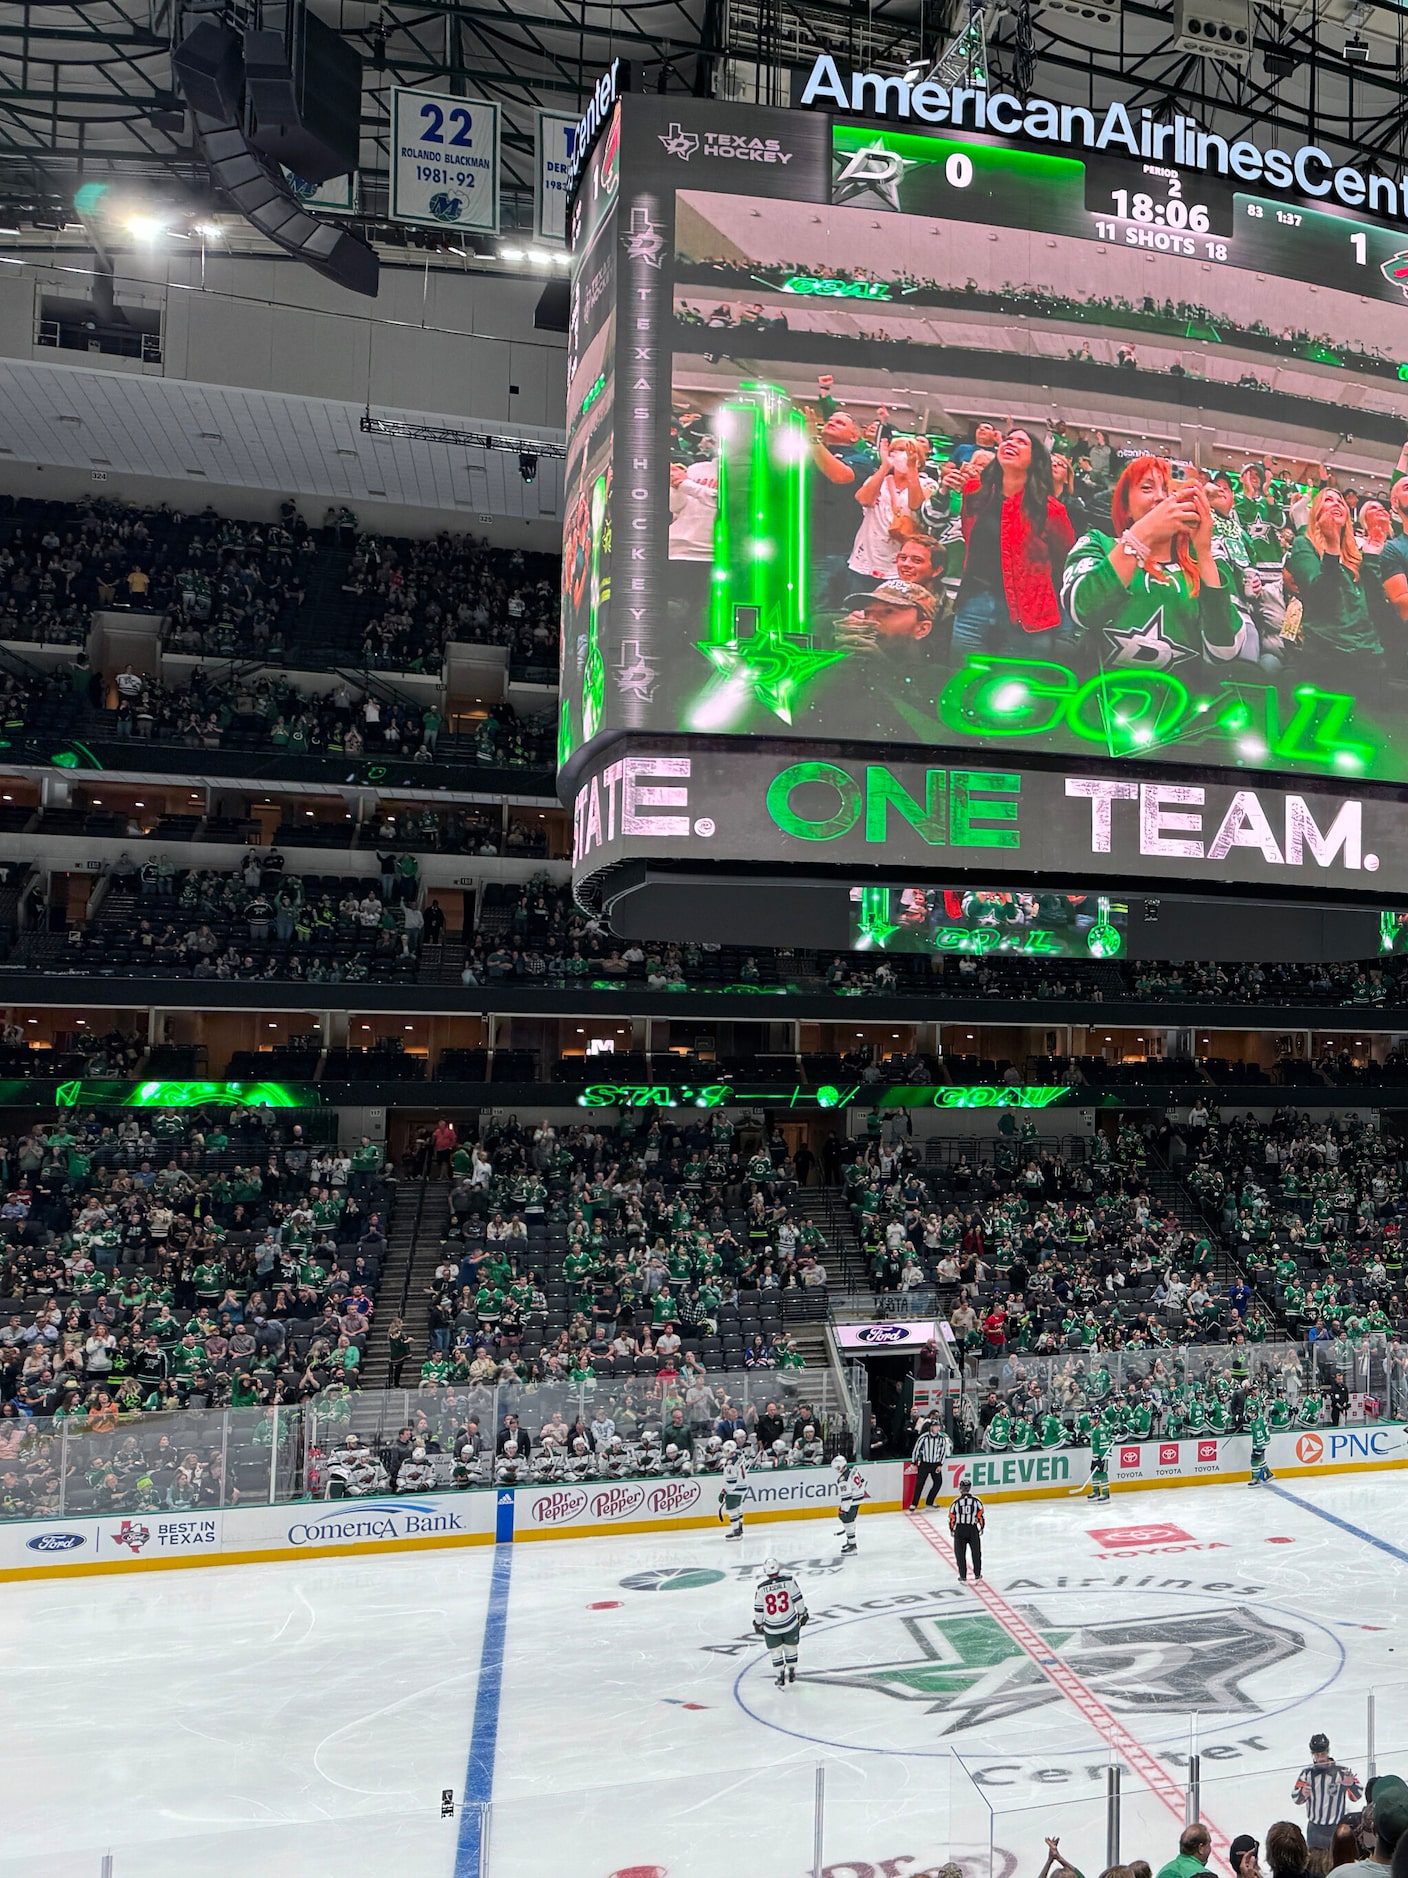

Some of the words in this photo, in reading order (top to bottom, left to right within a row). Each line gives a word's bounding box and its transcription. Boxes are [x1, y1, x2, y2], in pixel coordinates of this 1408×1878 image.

[419, 103, 473, 148] 22
[703, 132, 780, 152] TEXAS
[401, 147, 442, 163] ROLANDO
[445, 153, 490, 170] BLACKMAN
[703, 144, 794, 165] HOCKEY
[416, 164, 475, 189] 1981-92
[944, 152, 974, 189] 0
[1142, 164, 1179, 179] PERIOD
[1167, 178, 1183, 199] 2
[1111, 188, 1211, 234] 18:06
[1246, 204, 1264, 218] 83
[1275, 210, 1303, 228] 1:37
[1095, 221, 1117, 241] 11
[1125, 226, 1196, 256] SHOTS
[1205, 241, 1228, 262] 18
[1350, 232, 1367, 266] 1
[571, 756, 716, 869] STATE.
[766, 761, 1022, 849] ONE
[1064, 777, 1381, 872] TEAM.
[865, 1327, 902, 1342] Ford
[1328, 1431, 1396, 1459] PNC
[1116, 1471, 1144, 1479] TOYOTA
[1155, 1468, 1182, 1476] TOYOTA
[1194, 1465, 1220, 1473] TOYOTA
[551, 1491, 572, 1508] Dr
[610, 1487, 629, 1503] Dr
[653, 1486, 698, 1513] Pepper
[666, 1483, 686, 1498] Dr
[743, 1481, 840, 1502] American
[538, 1496, 584, 1522] Pepper
[596, 1490, 641, 1517] Pepper
[158, 1521, 197, 1534] BEST
[199, 1520, 216, 1532] IN
[404, 1512, 464, 1534] Bank
[37, 1533, 75, 1551] Ford
[157, 1532, 216, 1546] TEXAS
[1088, 1541, 1233, 1561] TOYOTA
[735, 1567, 844, 1582] ergy
[764, 1590, 790, 1616] 83
[699, 1584, 965, 1659] Arican
[1004, 1575, 1268, 1597] Airlines
[970, 1732, 1271, 1788] Center
